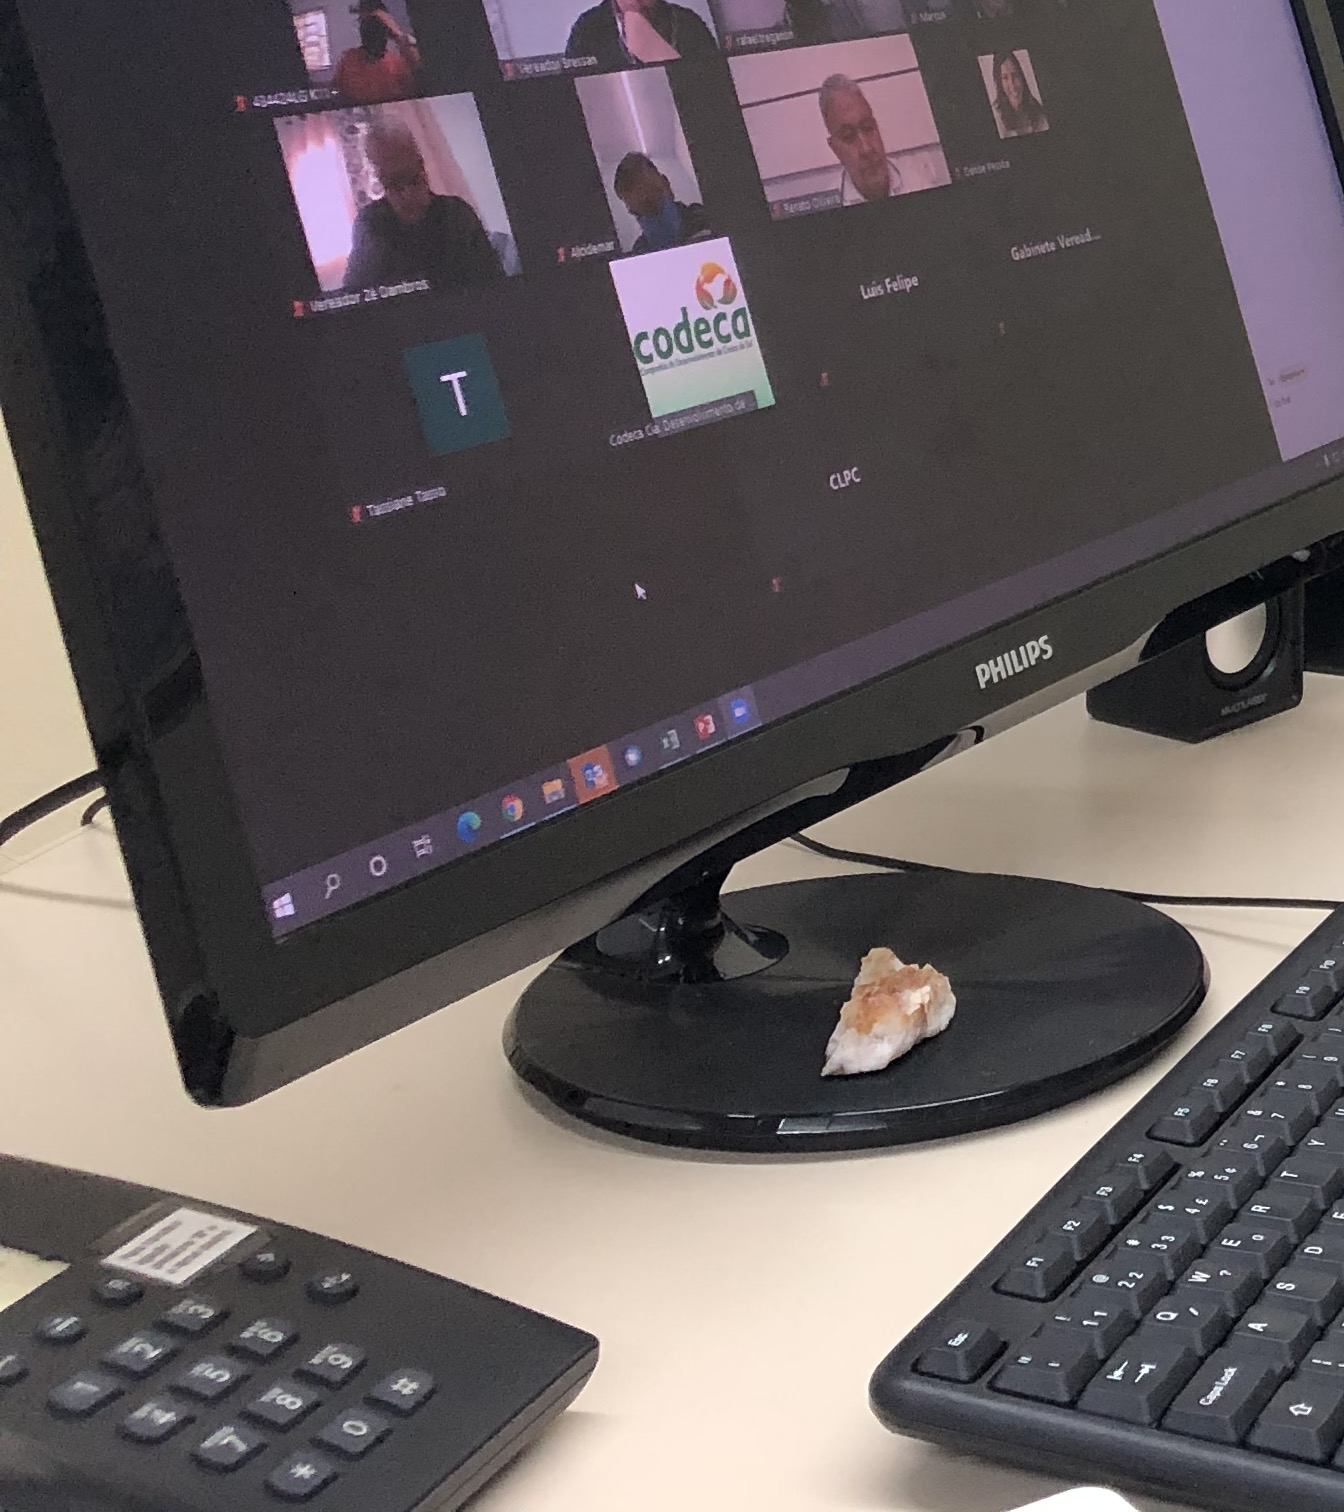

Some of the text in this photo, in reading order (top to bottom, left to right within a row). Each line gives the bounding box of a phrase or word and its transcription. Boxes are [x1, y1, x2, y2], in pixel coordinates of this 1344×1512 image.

[1011, 241, 1056, 261] Gabinete
[860, 274, 919, 300] Luis Felipe
[633, 306, 751, 365] codeca
[440, 370, 467, 417] T
[830, 467, 861, 489] CLPC
[975, 635, 1053, 689] PHILIPS
[1231, 1050, 1246, 1060] F7
[1307, 1139, 1325, 1147] Y
[1128, 1153, 1145, 1163] F4
[1280, 1170, 1298, 1178] T
[1096, 1186, 1113, 1197] F3
[1251, 1204, 1271, 1213] R
[1062, 1220, 1081, 1231] F2
[1221, 1238, 1241, 1247] E
[1304, 1246, 1323, 1255] D
[1025, 1257, 1044, 1267] F1
[1188, 1271, 1211, 1283] W
[1117, 1280, 1136, 1289] 2
[1276, 1281, 1296, 1291] S
[1155, 1311, 1179, 1321] Q
[1248, 1322, 1268, 1332] A
[261, 1327, 284, 1343] 6
[135, 1343, 162, 1360] 2
[329, 1354, 354, 1370] 9
[276, 1393, 303, 1410] 8
[342, 1419, 368, 1436] 0
